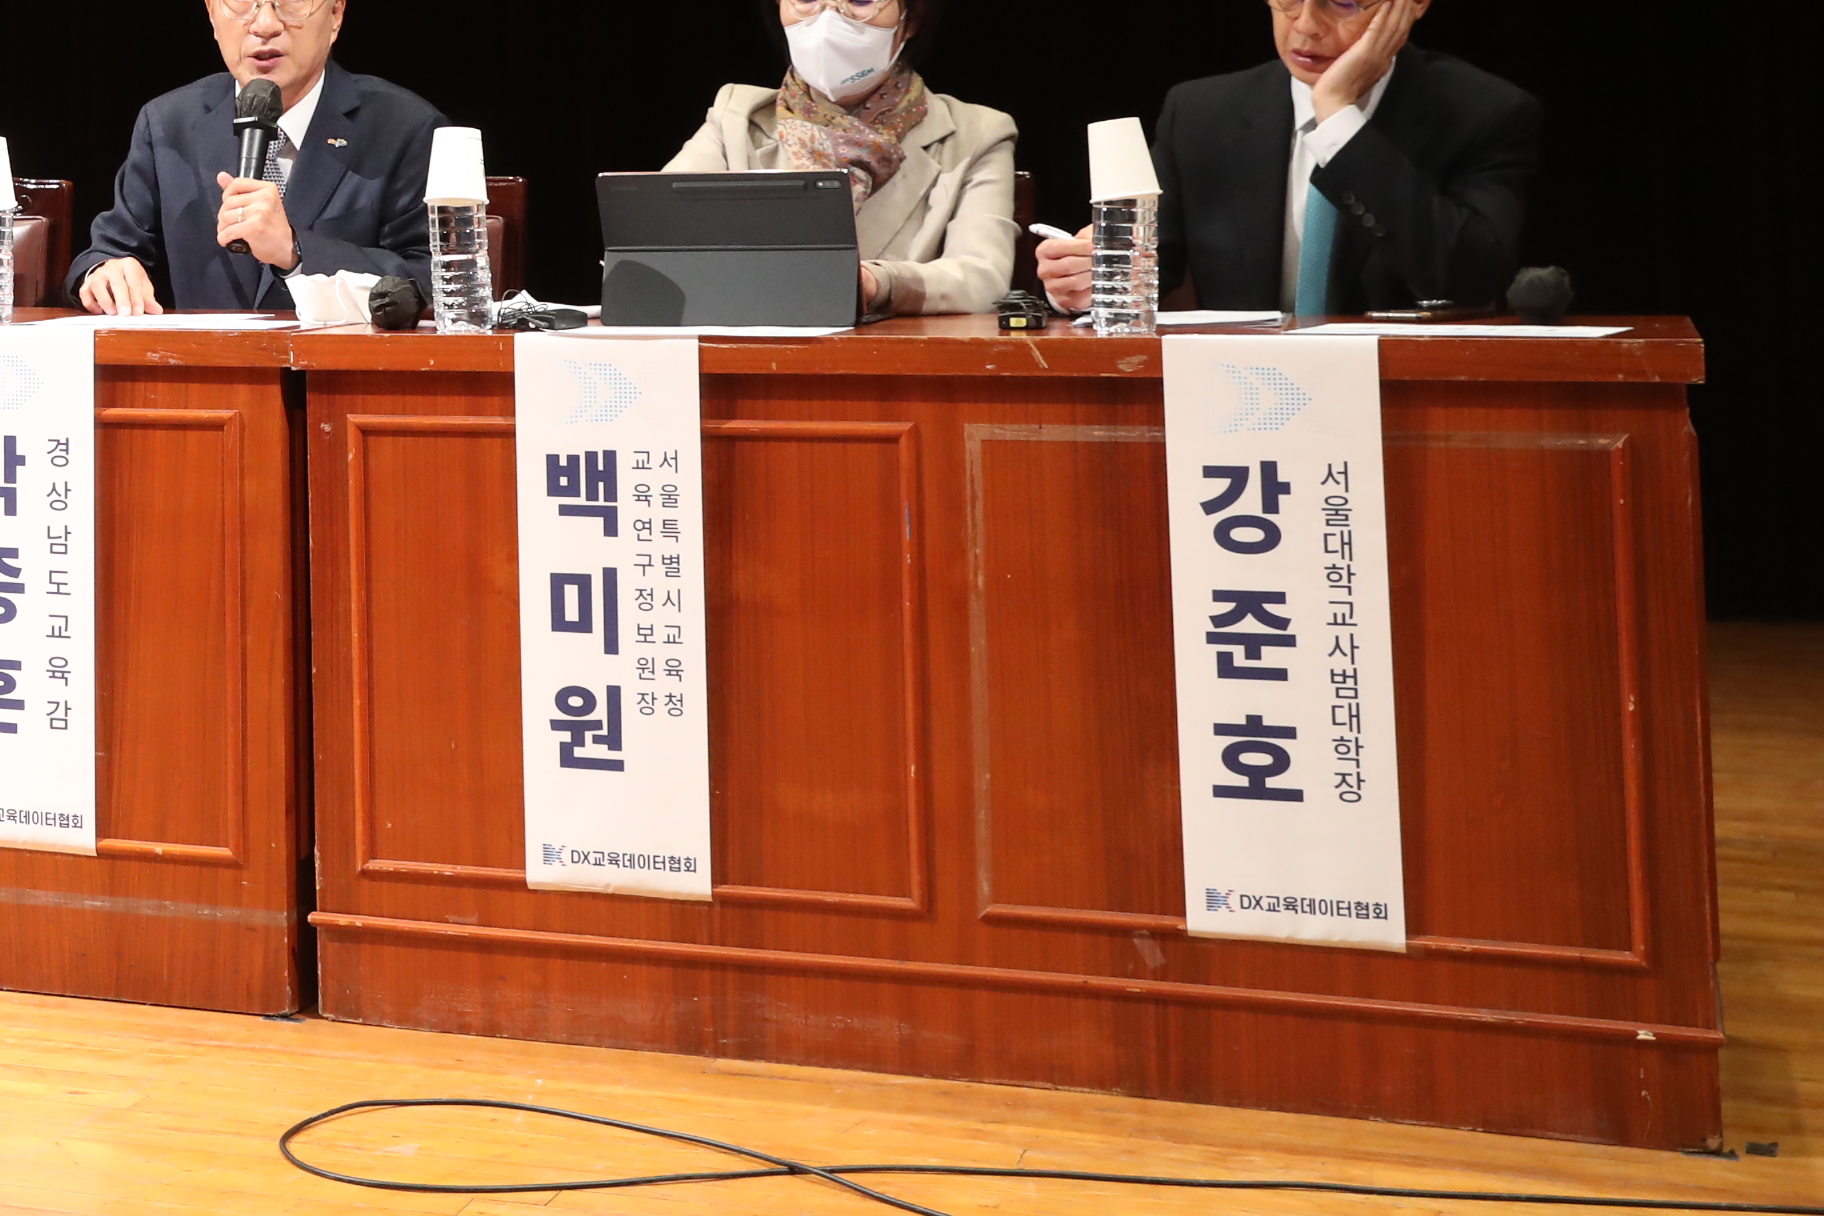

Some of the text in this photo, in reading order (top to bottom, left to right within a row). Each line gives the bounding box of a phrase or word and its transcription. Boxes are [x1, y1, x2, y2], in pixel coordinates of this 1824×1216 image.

[45, 437, 72, 731] 경상남도교육감
[545, 449, 625, 773] 백미원
[631, 450, 657, 716] 교육연구정보원장
[658, 449, 685, 717] 서울특별시교육청
[1199, 460, 1305, 803] 강준호
[1320, 460, 1366, 804] 서울대학교사범대학장
[570, 849, 697, 874] DX교육데이터협회
[1239, 894, 1388, 921] DX교육데이터협회
